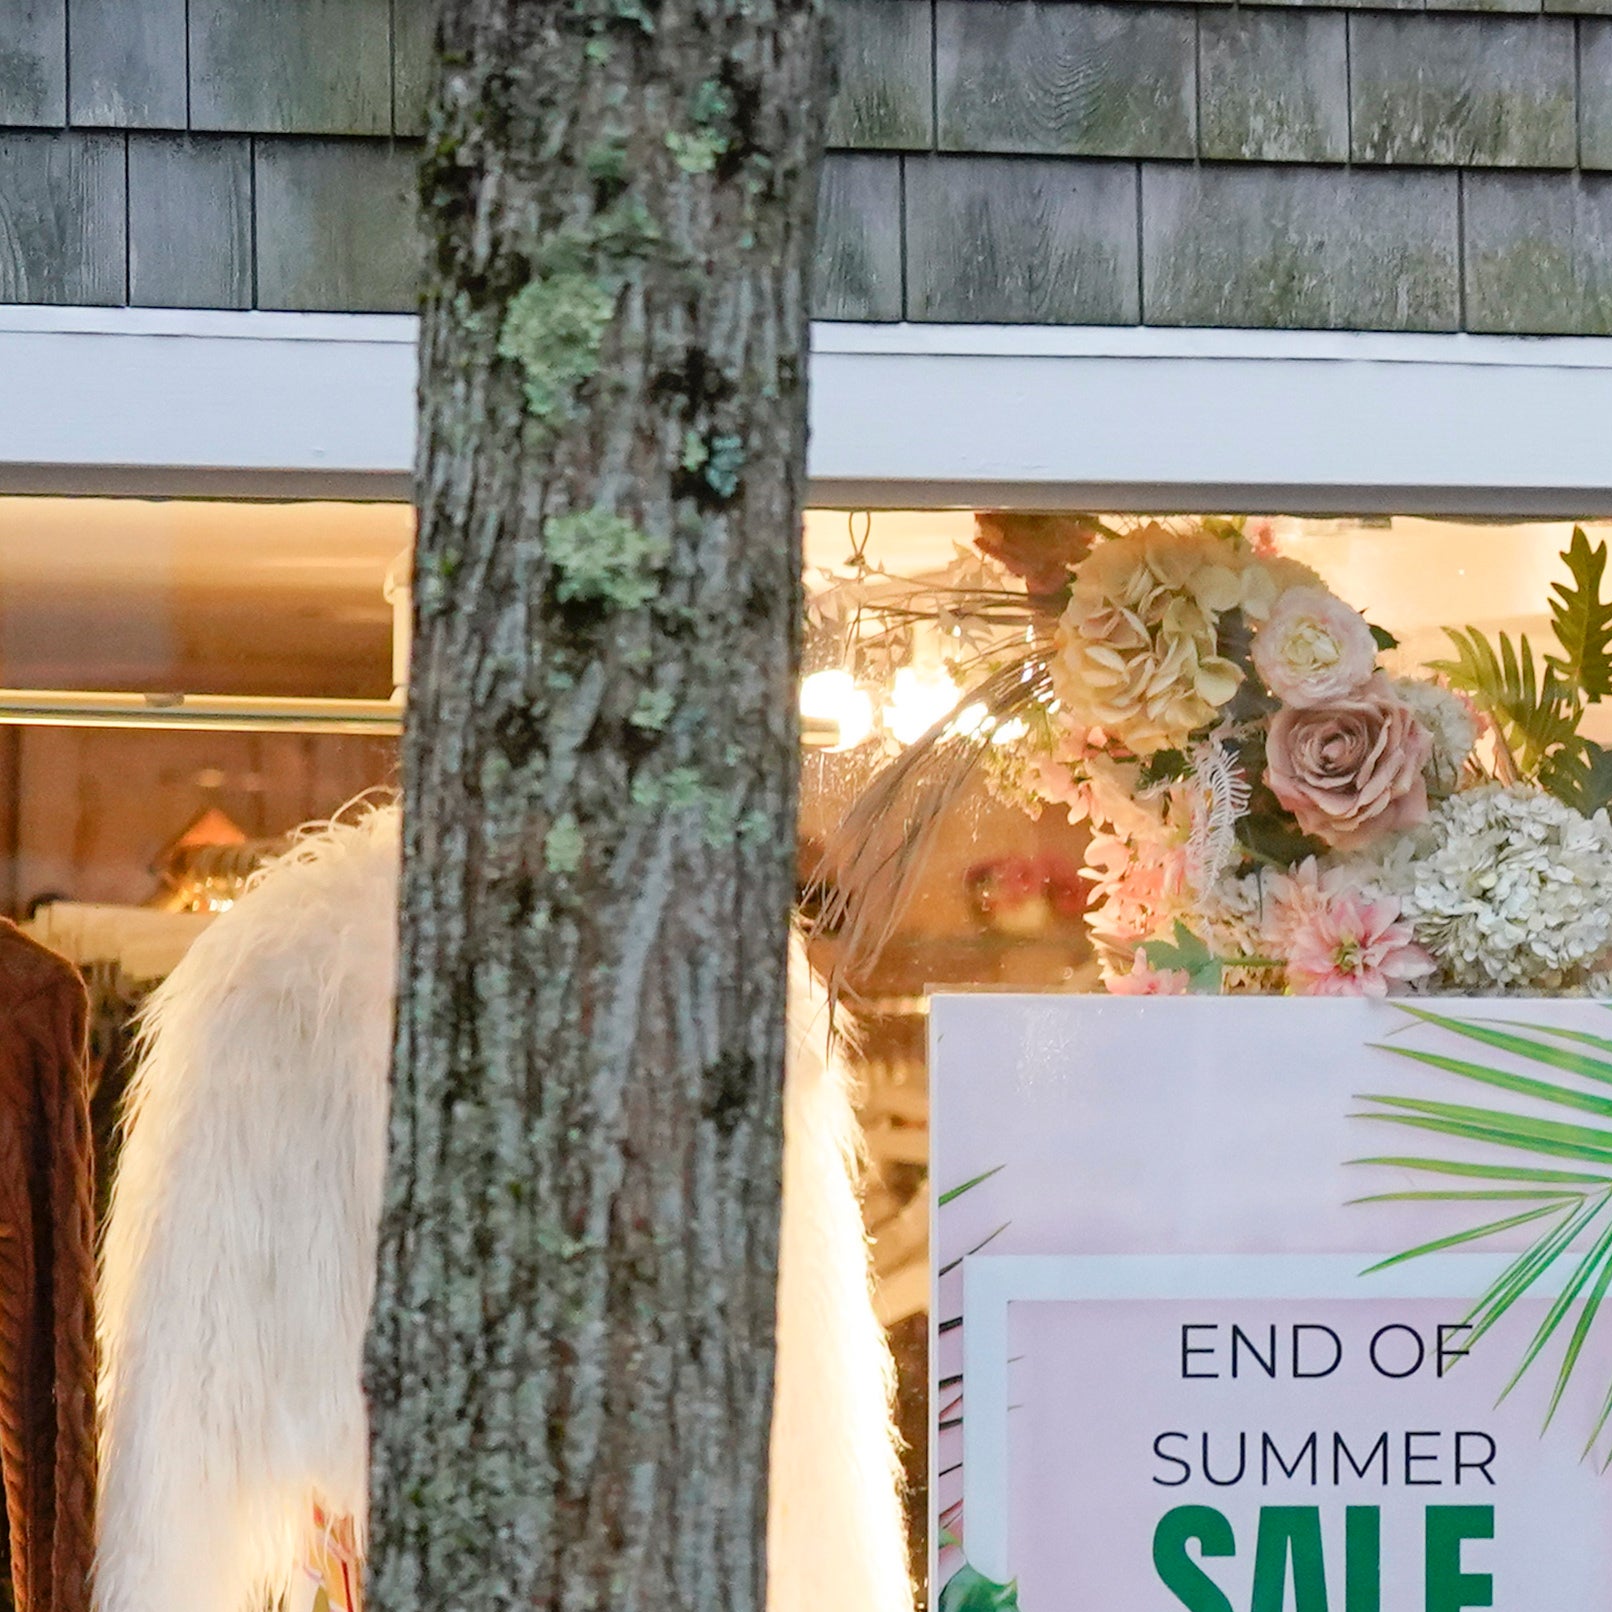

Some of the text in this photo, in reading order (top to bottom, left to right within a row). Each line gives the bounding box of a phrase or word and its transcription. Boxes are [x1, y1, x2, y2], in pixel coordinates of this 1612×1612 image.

[1182, 1323, 1474, 1379] END OF
[1152, 1430, 1497, 1487] SUMMER
